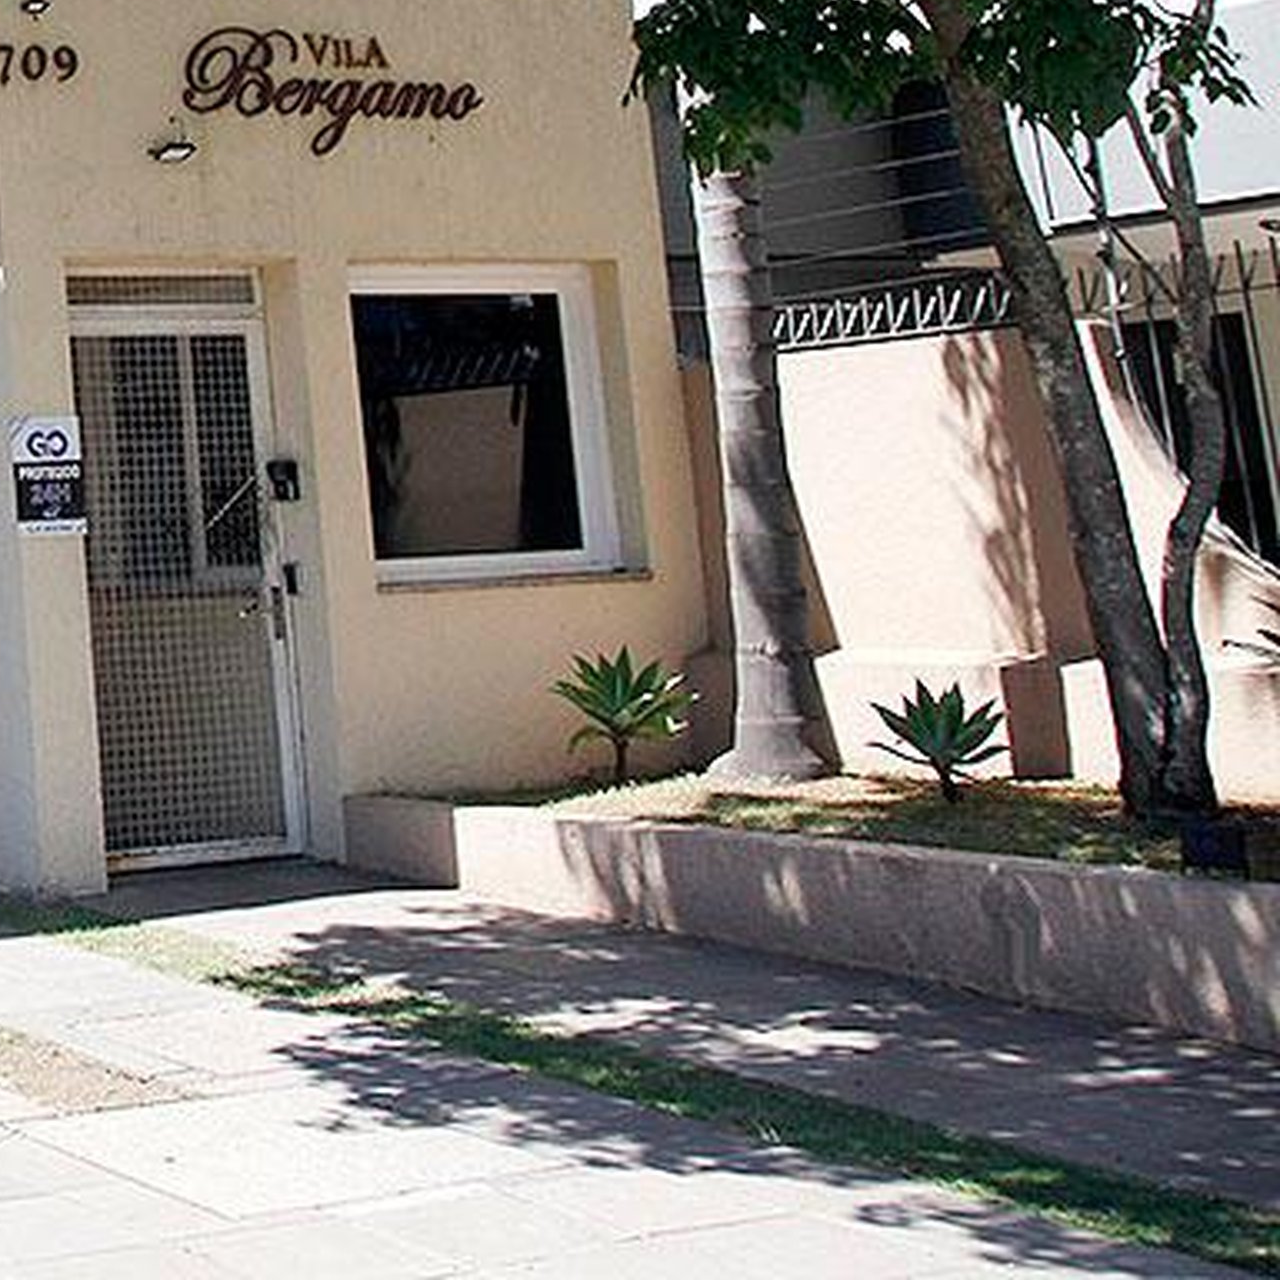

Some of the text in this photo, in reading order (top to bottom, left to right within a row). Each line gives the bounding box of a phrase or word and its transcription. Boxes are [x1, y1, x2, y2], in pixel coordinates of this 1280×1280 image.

[302, 32, 390, 69] VILA
[182, 26, 484, 156] Bergamo
[27, 430, 68, 457] GO
